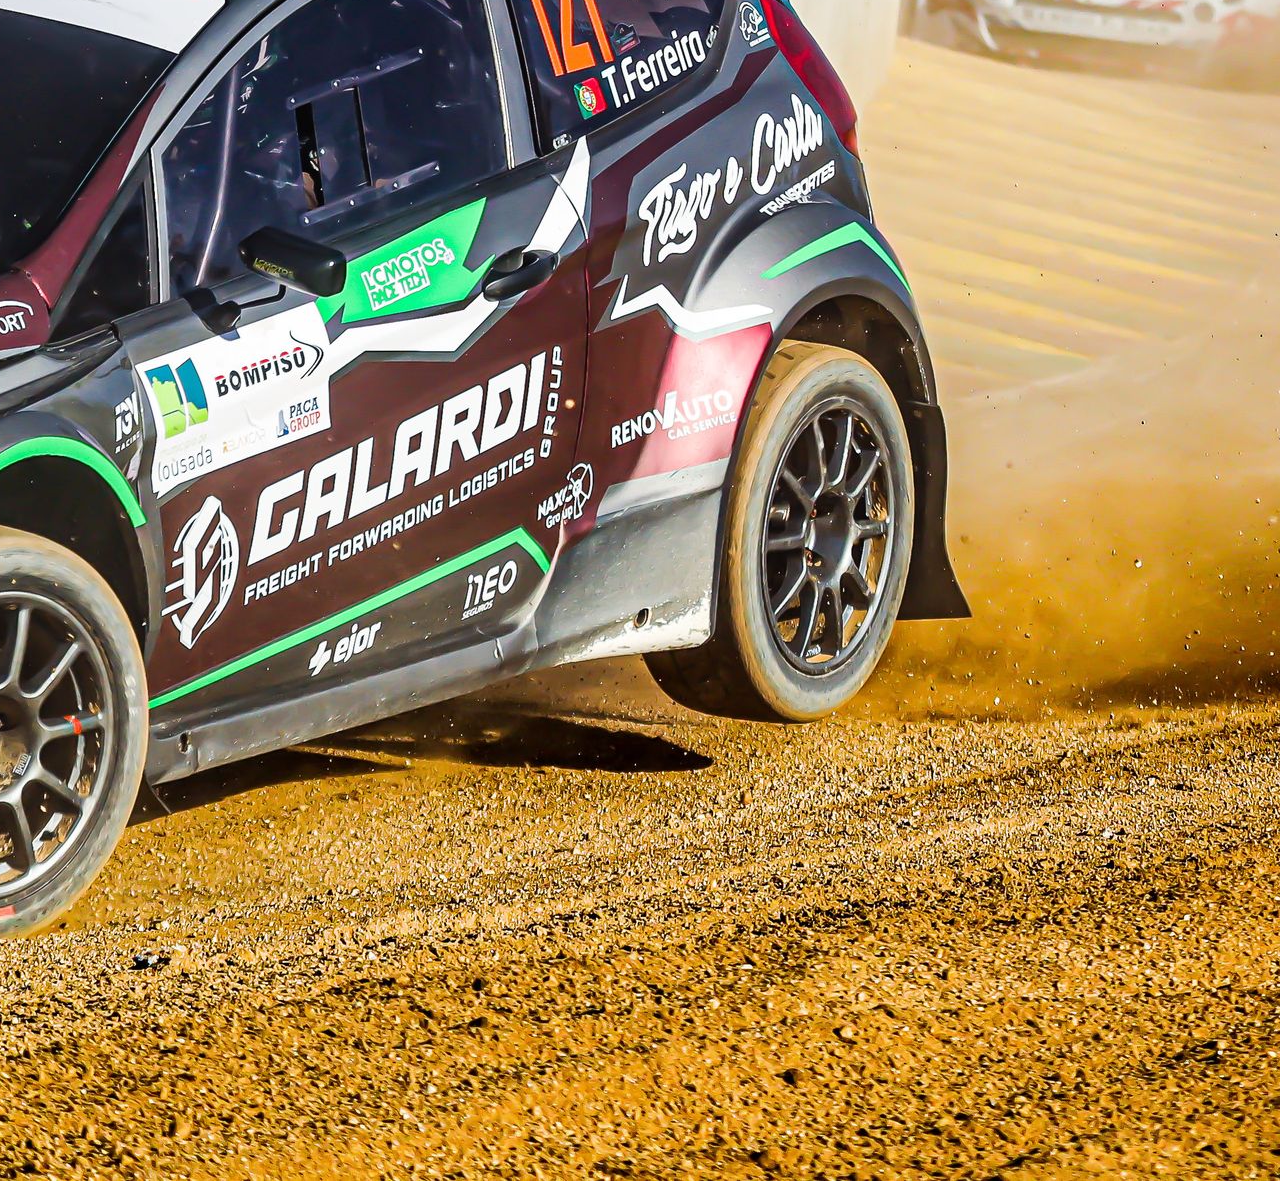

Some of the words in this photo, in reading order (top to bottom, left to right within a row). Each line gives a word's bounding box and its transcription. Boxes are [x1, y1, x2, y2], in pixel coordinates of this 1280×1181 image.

[638, 161, 721, 268] Tiago
[723, 156, 744, 205] e
[750, 93, 824, 196] Carla
[759, 159, 836, 217] TRANSPORTES
[289, 396, 320, 419] PACA
[289, 410, 321, 434] GROUP
[539, 344, 564, 459] GROUP
[667, 427, 692, 441] CAR
[694, 411, 737, 433] SERVICE
[247, 350, 547, 567] GALARDI
[242, 550, 324, 606] FREIGHT
[327, 494, 444, 568] FORWARDING
[448, 446, 536, 506] LOGISTICS
[545, 505, 574, 530] Group
[461, 600, 495, 622] SEGUROS
[332, 622, 383, 664] ejor
